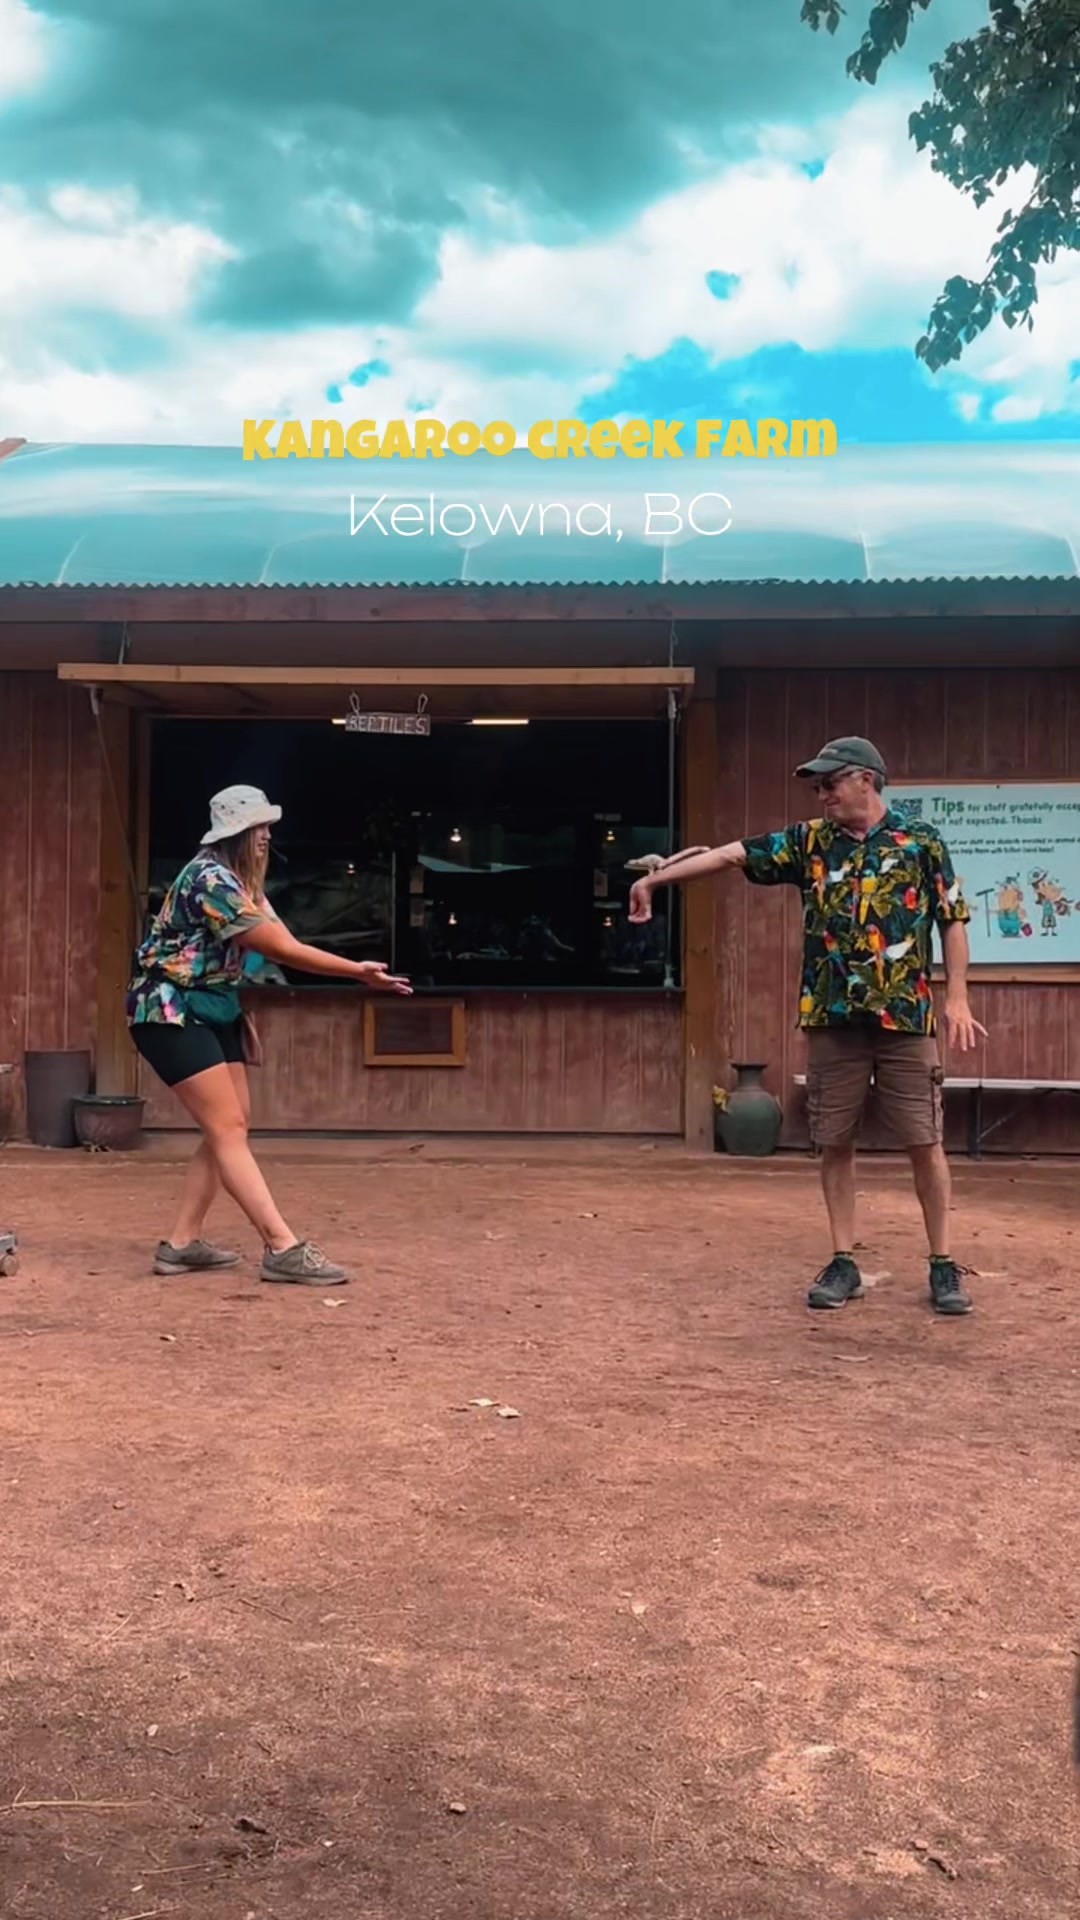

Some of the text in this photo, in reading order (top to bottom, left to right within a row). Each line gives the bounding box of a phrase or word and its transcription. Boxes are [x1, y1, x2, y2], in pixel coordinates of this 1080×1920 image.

[349, 715, 428, 735] REPTILES
[931, 797, 965, 817] Tips
[968, 803, 981, 812] for
[984, 802, 1007, 812] staff
[1009, 802, 1053, 814] gratefully
[931, 817, 946, 826] but
[949, 816, 963, 826] not
[1011, 815, 1042, 825] Thanks
